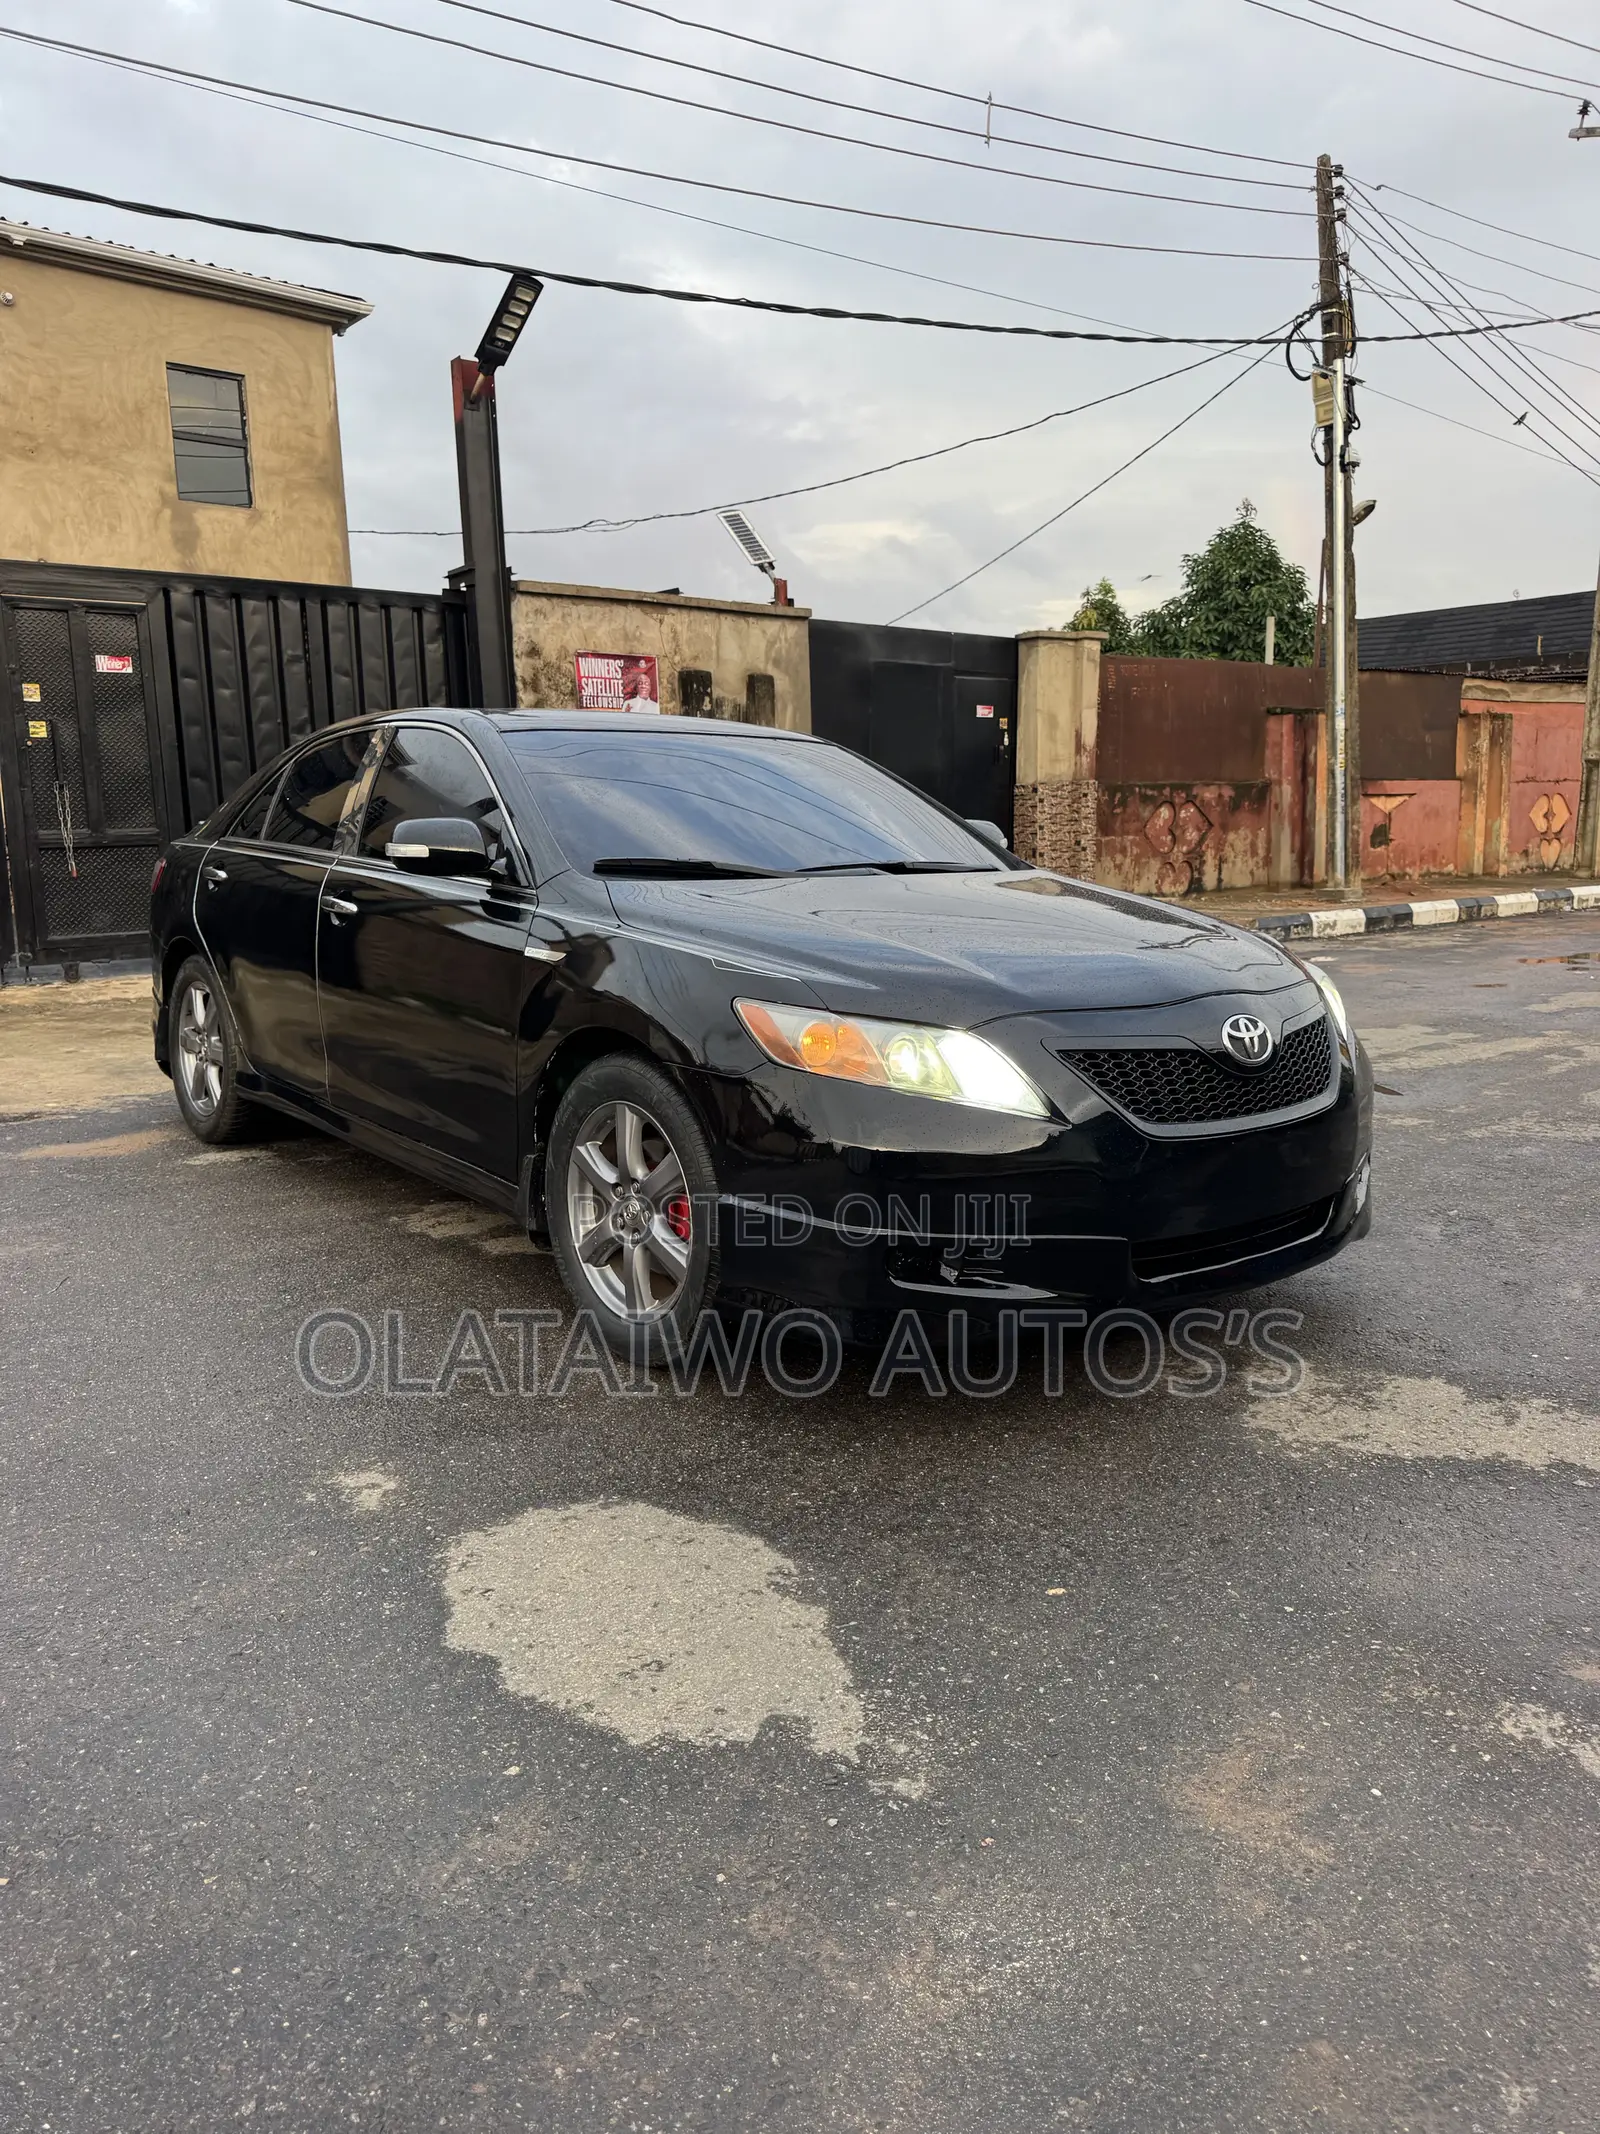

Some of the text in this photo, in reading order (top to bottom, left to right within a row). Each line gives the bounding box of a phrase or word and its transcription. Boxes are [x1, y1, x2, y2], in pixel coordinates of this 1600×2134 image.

[578, 656, 624, 679] WINNERS'
[581, 678, 624, 697] SATELLITE
[582, 696, 624, 709] FELLOWSHIP
